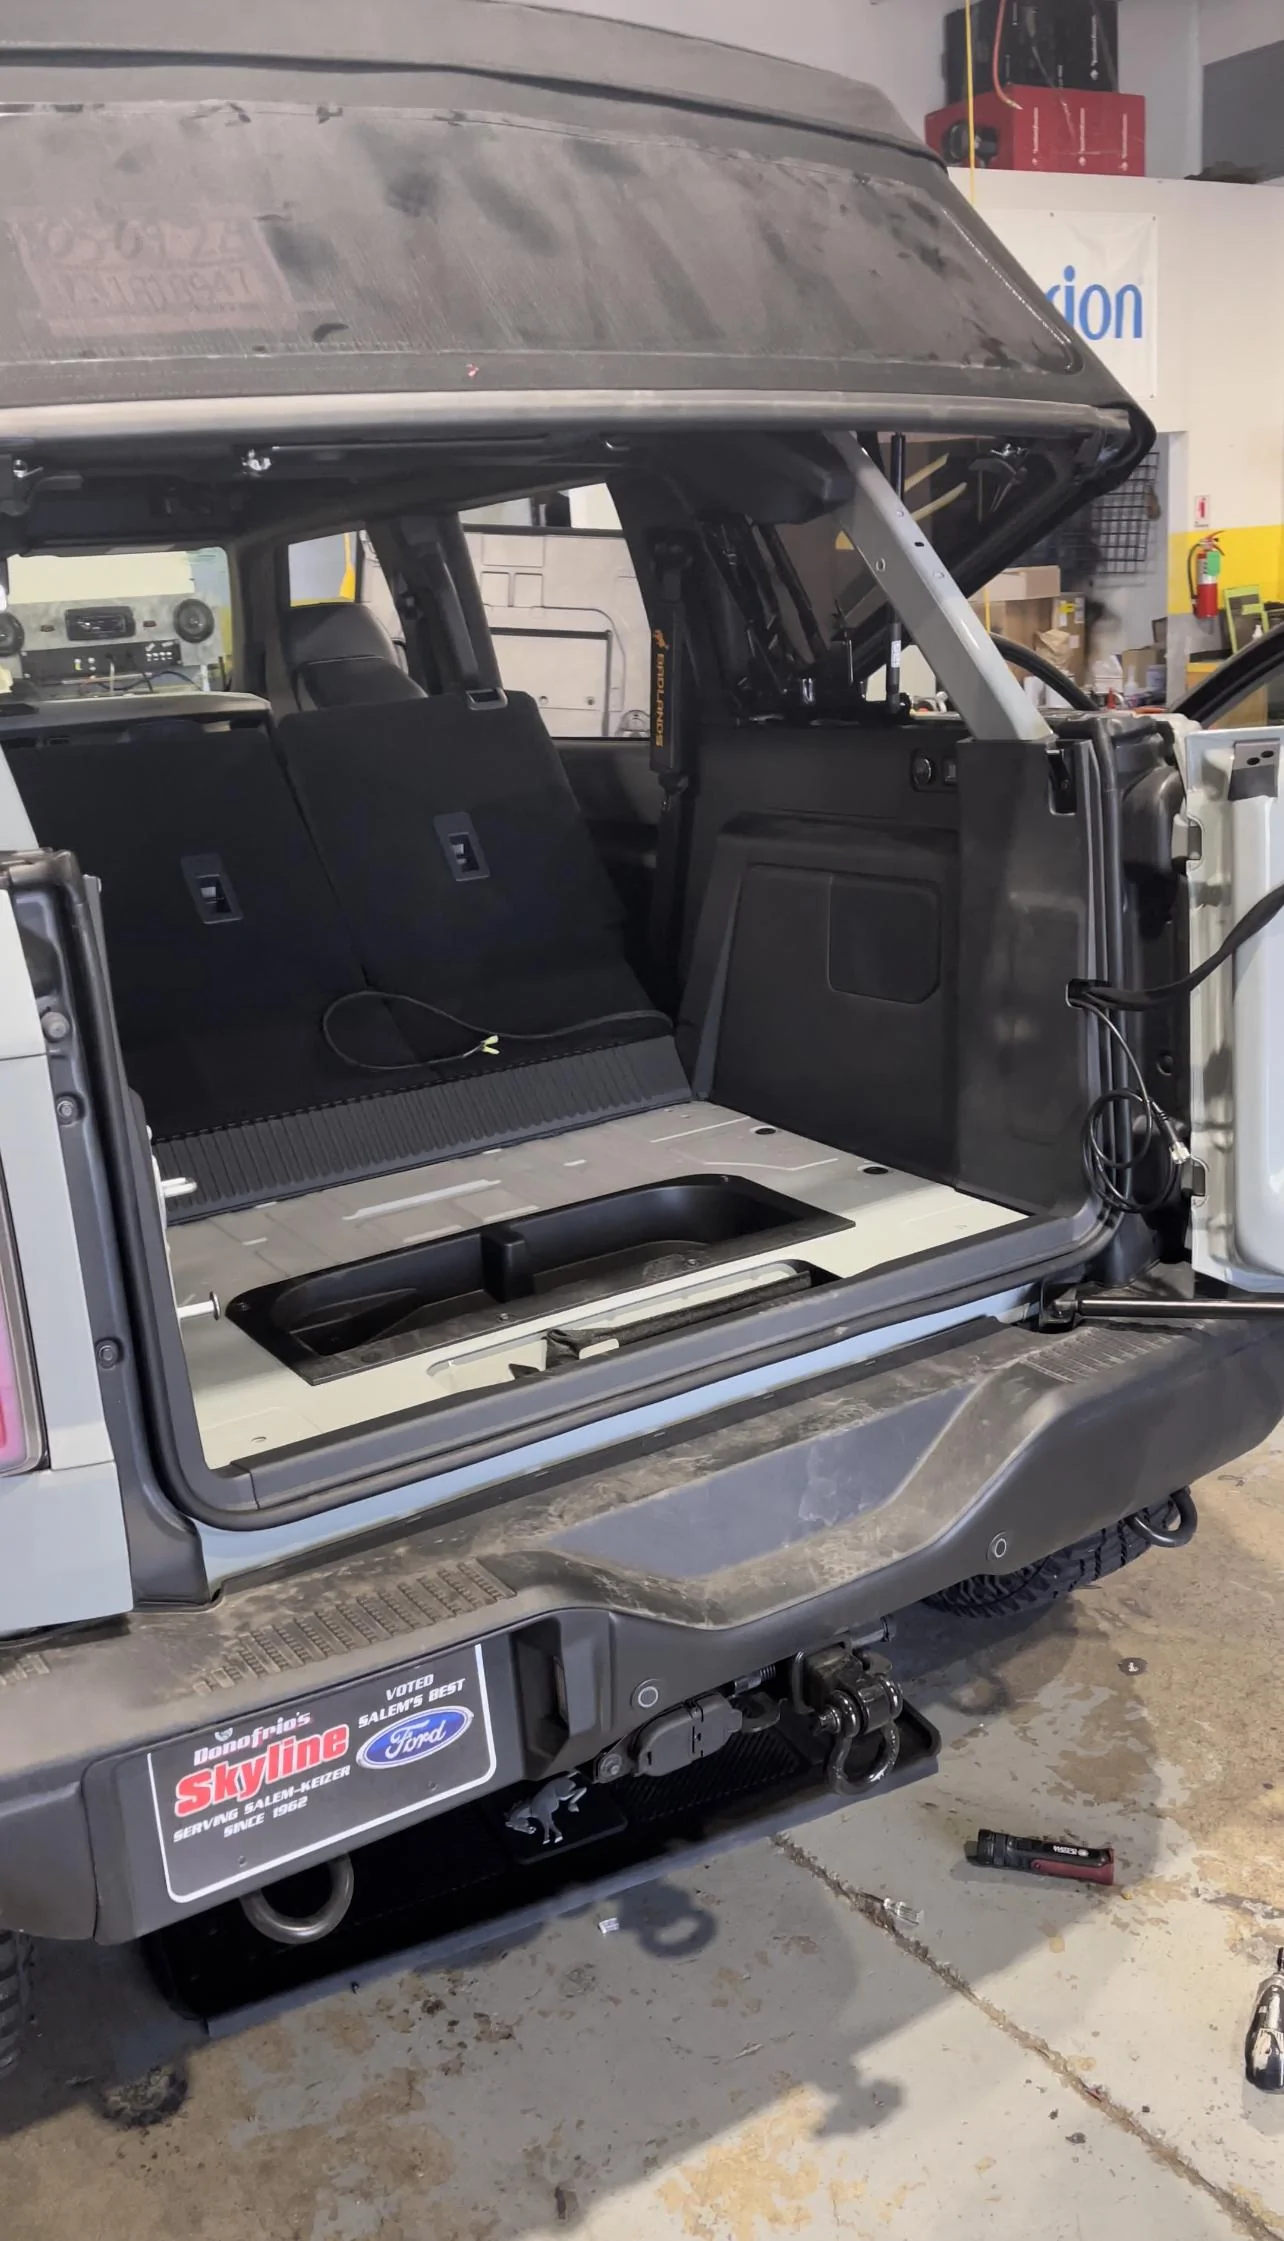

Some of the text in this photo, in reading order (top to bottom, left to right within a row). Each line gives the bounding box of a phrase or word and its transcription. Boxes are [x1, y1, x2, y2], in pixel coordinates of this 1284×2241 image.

[655, 653, 665, 747] BADLANDS
[358, 1678, 466, 1729] SALEM'S BEST
[385, 1673, 435, 1701] VOTED
[193, 1711, 311, 1767] Donofrio's
[384, 1719, 447, 1759] Ford
[174, 1723, 350, 1818] Skyline
[173, 1764, 351, 1843] SERVING SALEM-KEIZER
[223, 1796, 309, 1838] SINCE 1962
